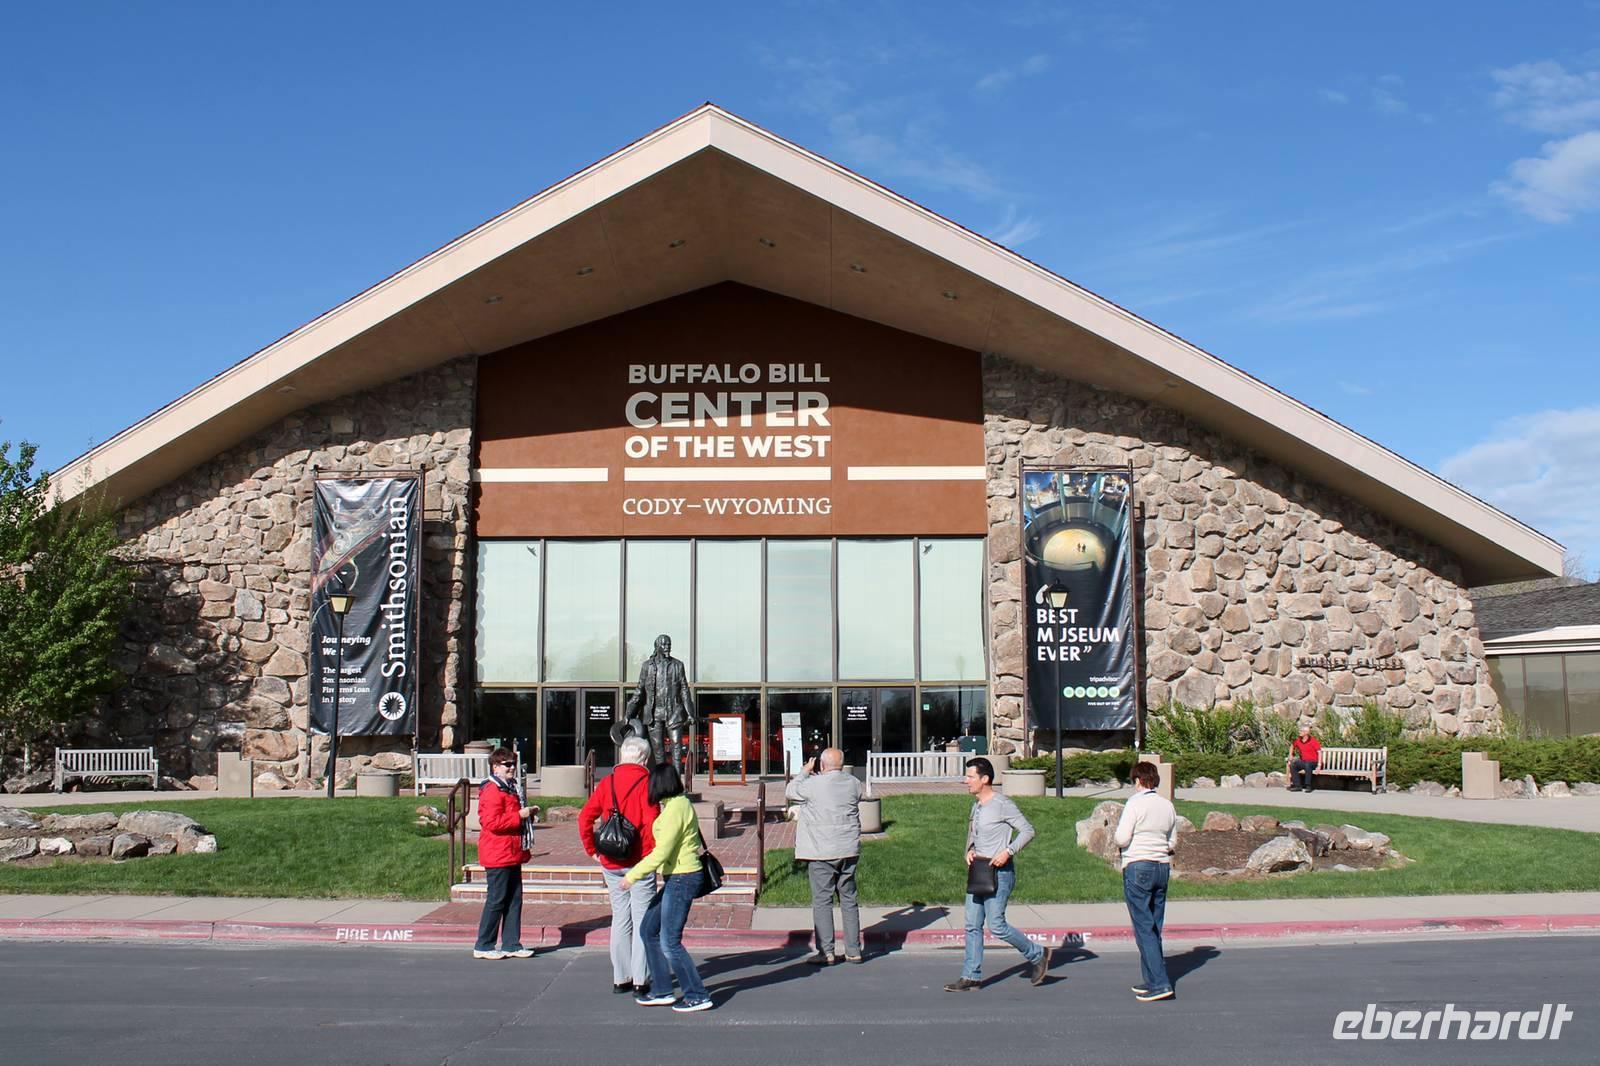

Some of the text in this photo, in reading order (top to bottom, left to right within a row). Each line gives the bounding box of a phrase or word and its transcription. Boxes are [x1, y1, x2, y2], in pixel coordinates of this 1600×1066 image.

[628, 363, 830, 384] BUFFALO BILL
[625, 391, 832, 429] CENTER
[624, 435, 831, 459] OF THE WEST
[380, 495, 408, 678] Smithsonian
[1037, 608, 1079, 624] BEST
[321, 635, 371, 646] Jouneying
[322, 647, 344, 656] Wet
[322, 666, 362, 676] The argest
[336, 927, 414, 942] FIRE LANE
